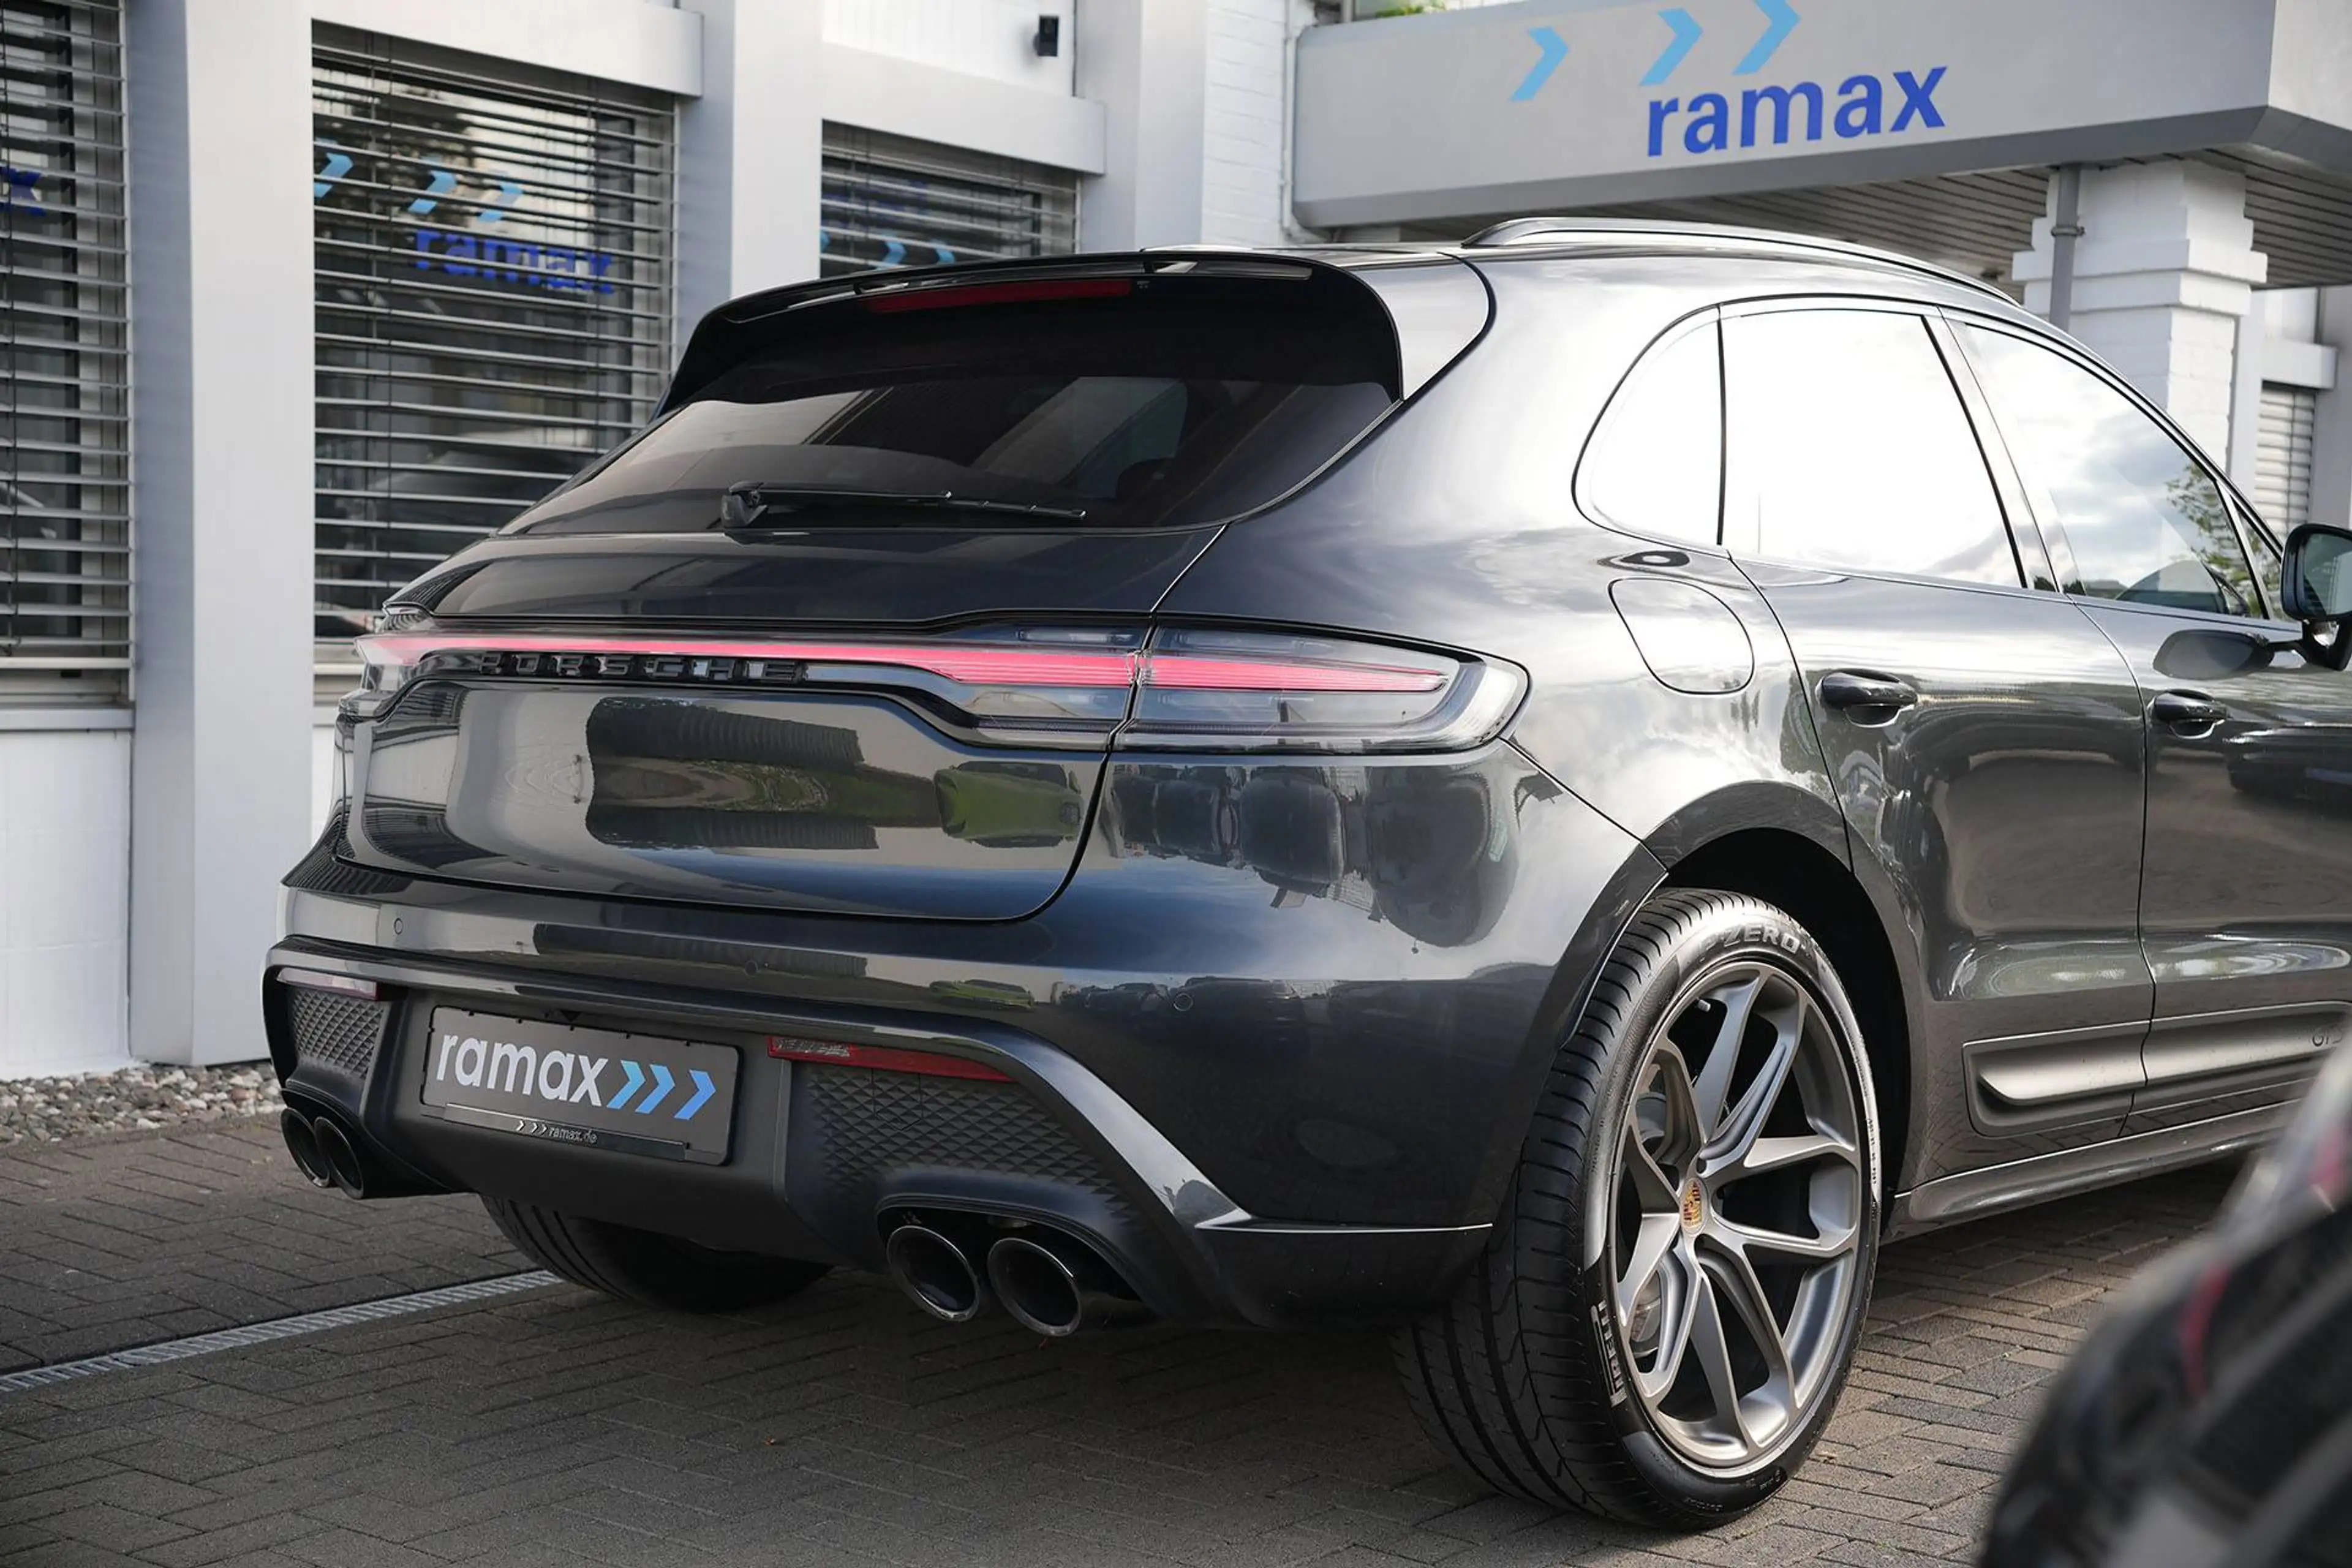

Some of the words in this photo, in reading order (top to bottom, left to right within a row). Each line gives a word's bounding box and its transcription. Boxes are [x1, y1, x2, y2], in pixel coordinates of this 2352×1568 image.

[1648, 66, 1947, 157] ramax
[415, 229, 613, 294] ramax
[479, 653, 796, 682] PORSCHE
[1723, 921, 1800, 955] ZERO
[436, 1035, 609, 1107] ramax
[548, 1127, 598, 1144] ramax.de
